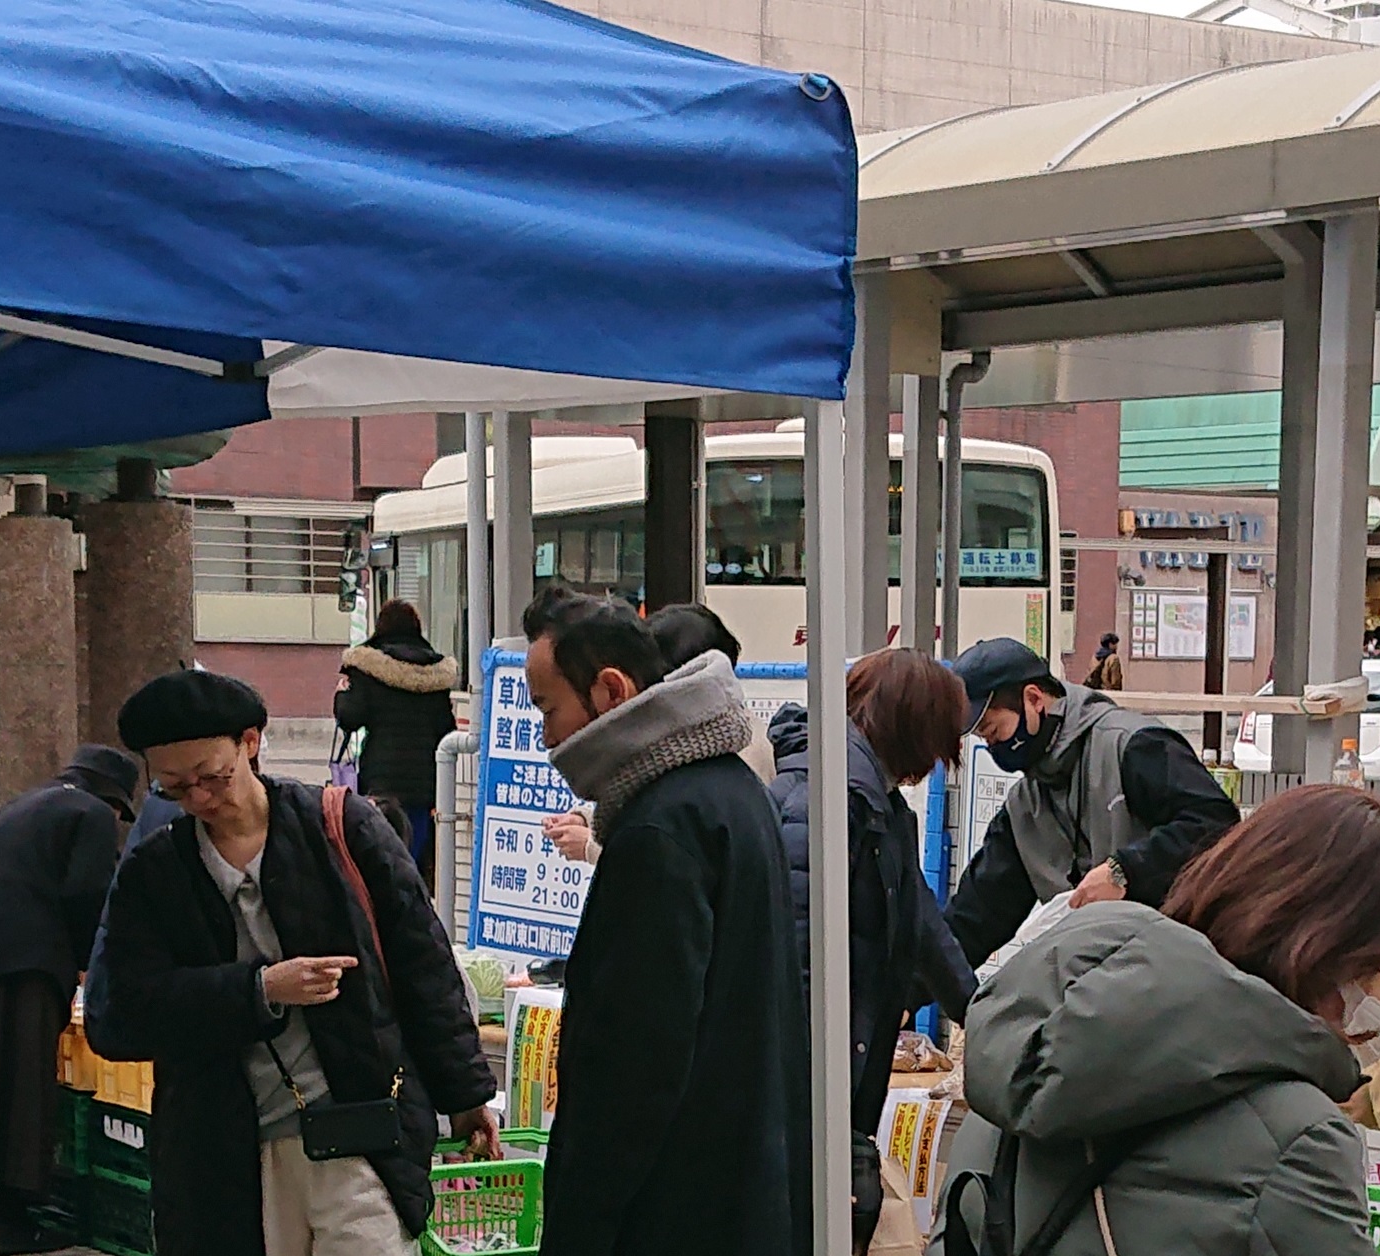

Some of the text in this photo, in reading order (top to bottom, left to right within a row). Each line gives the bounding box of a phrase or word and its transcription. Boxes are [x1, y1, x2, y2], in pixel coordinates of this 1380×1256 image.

[490, 864, 527, 892] 時間帯
[532, 886, 580, 909] 21:00
